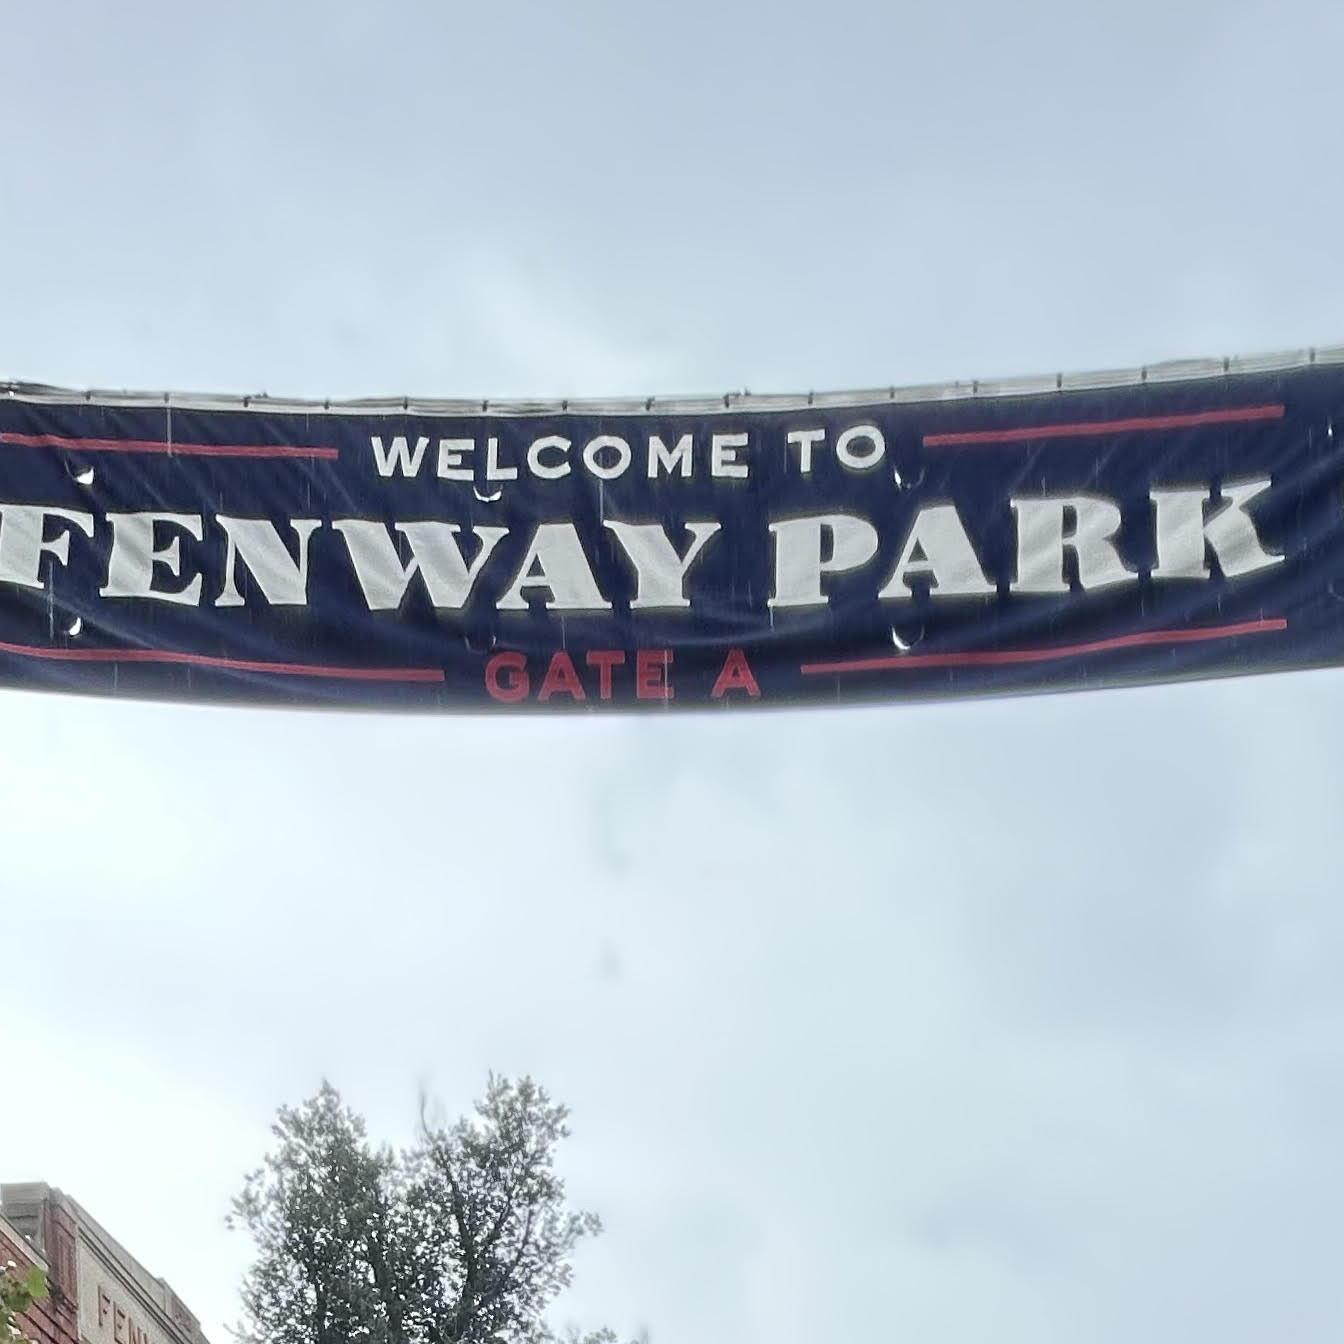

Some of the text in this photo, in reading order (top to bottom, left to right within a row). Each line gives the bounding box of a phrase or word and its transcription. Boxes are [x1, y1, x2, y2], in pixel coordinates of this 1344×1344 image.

[370, 423, 886, 481] WELCOME TO
[768, 475, 1285, 608] PARK
[484, 648, 761, 702] GATE A
